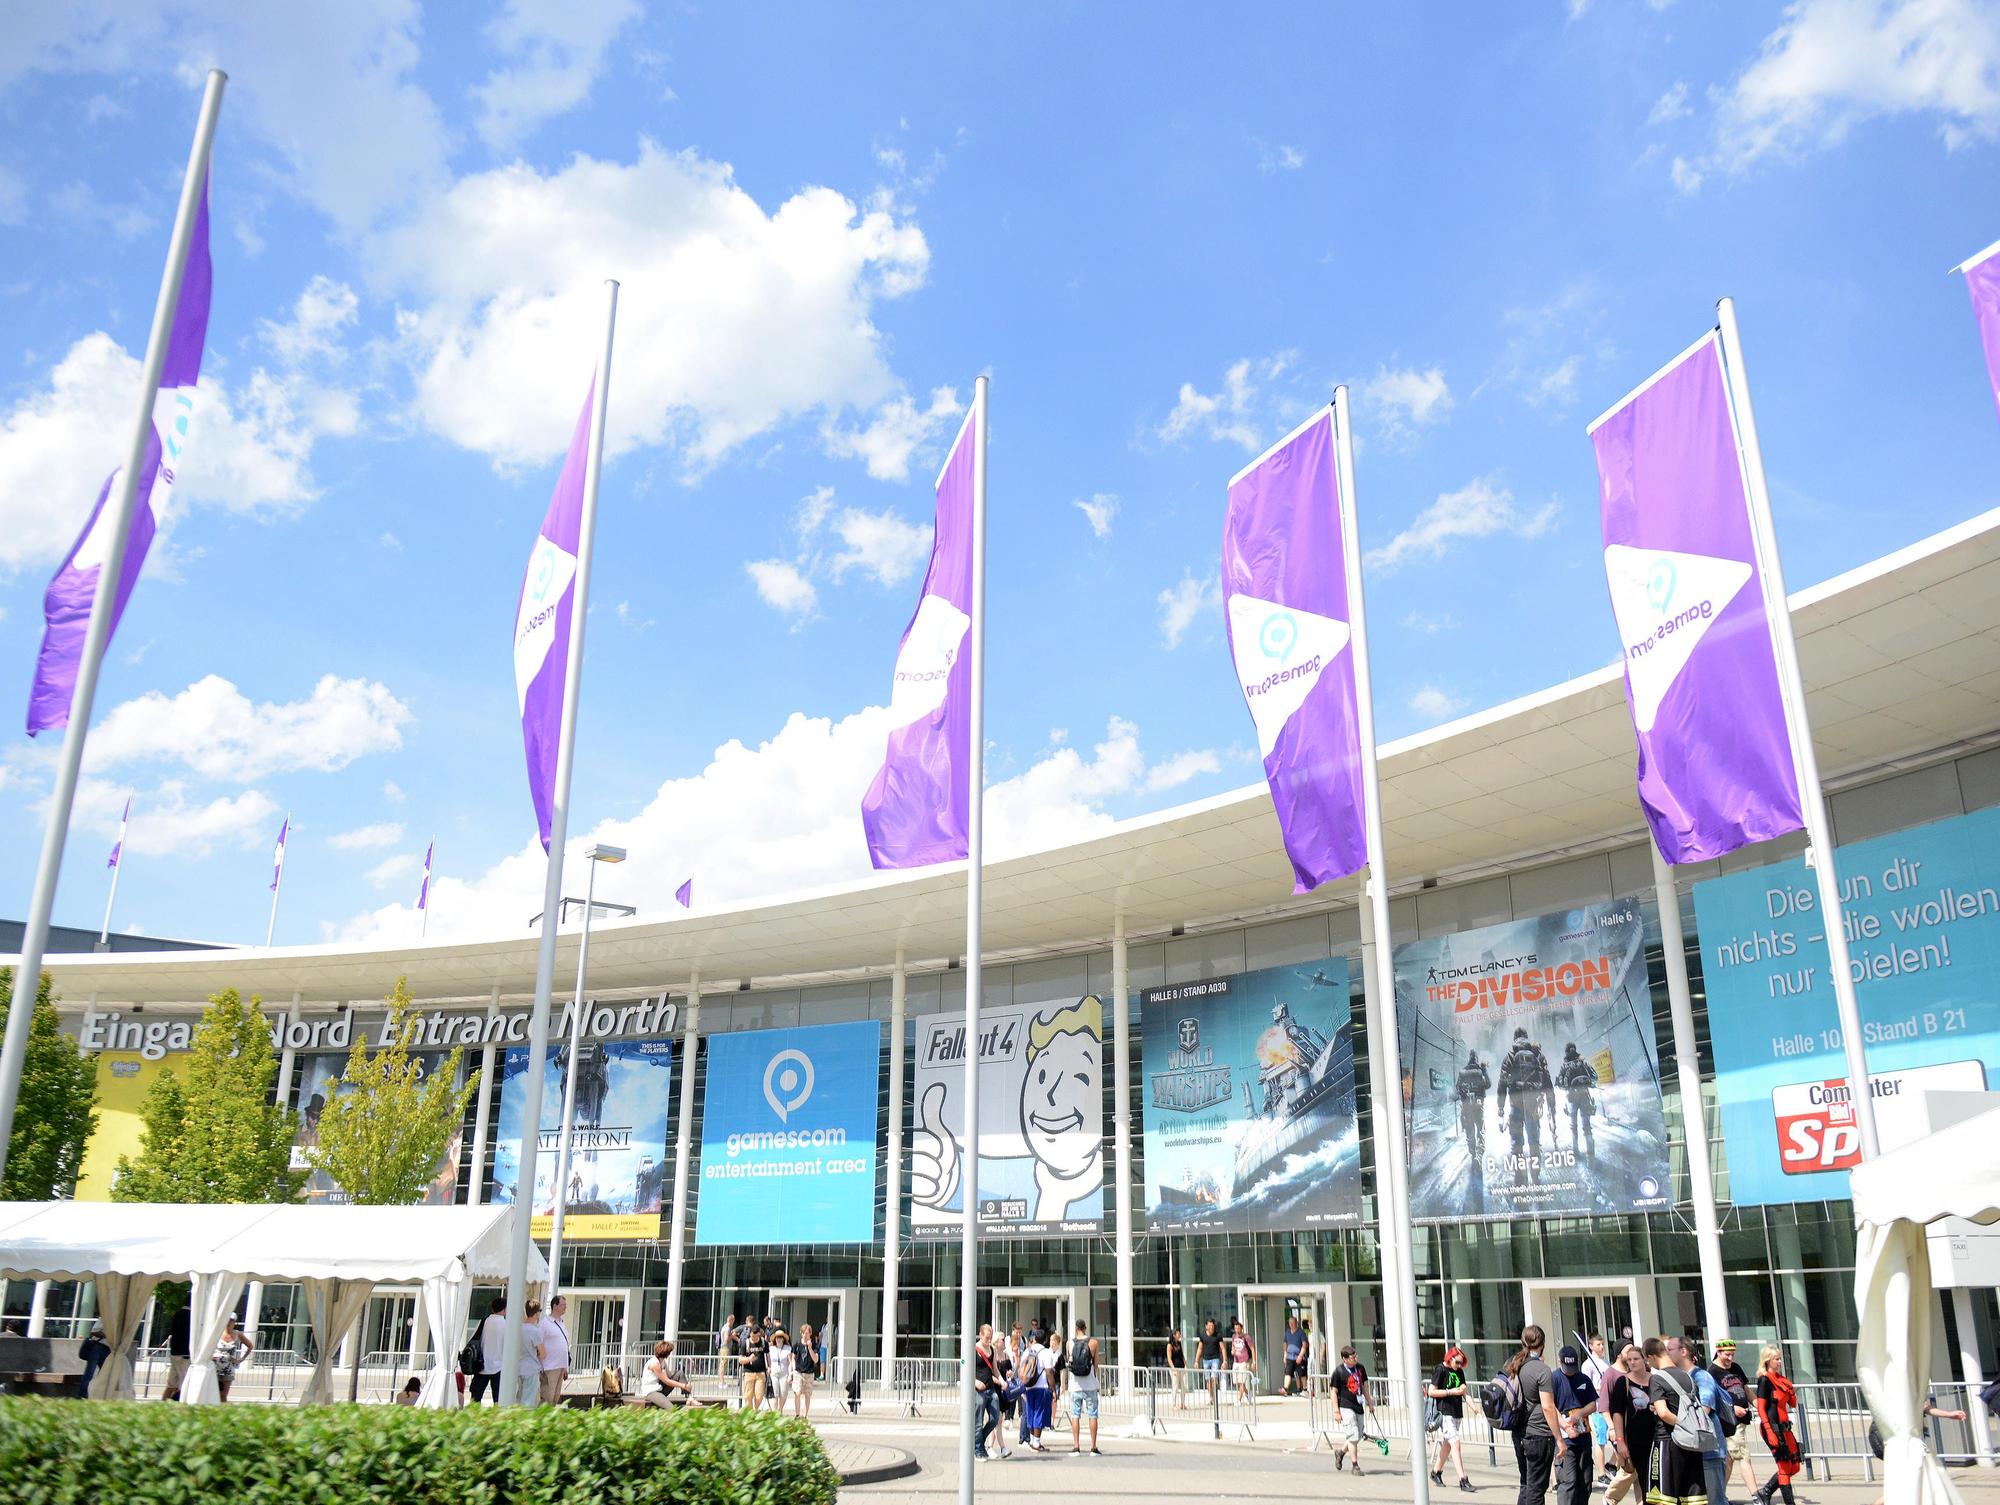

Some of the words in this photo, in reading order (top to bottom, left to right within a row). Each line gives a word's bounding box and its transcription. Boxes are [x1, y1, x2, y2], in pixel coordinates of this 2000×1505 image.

[1766, 885, 1814, 919] Die
[1837, 874, 1873, 904] un
[1882, 857, 1921, 892] dir
[1600, 913, 1624, 927] Halle
[1625, 910, 1633, 922] 6
[1717, 930, 1797, 968] nichts
[1891, 887, 2000, 932] wollen
[1558, 929, 1595, 943] gamescom
[1439, 965, 1468, 980] TOM
[1469, 954, 1538, 975] CLANCY'S
[1150, 990, 1171, 1002] HALLE
[1172, 989, 1178, 999] 8
[1183, 985, 1207, 998] STAND
[1208, 981, 1227, 993] A030
[1426, 983, 1457, 1002] THE
[1455, 956, 1611, 1013] DIVISION
[1768, 967, 1816, 998] nur
[556, 992, 678, 1039] North
[928, 1024, 999, 1061] Fallut
[999, 1021, 1016, 1054] 4
[1772, 1035, 1815, 1057] Halle
[1864, 1016, 1918, 1044] Stand
[1923, 1012, 1938, 1034] B
[1943, 1007, 1967, 1031] 21
[1168, 1047, 1214, 1070] WORLD
[1152, 1070, 1232, 1107] WARSHIPS
[1809, 1078, 1903, 1105] Comter
[1158, 1118, 1187, 1135] ACTION
[1189, 1113, 1228, 1133] STATIONS
[726, 1127, 846, 1157] gamescom
[1164, 1136, 1222, 1148] worldofwarships.eu
[705, 1158, 822, 1179] entertainment
[826, 1158, 867, 1174] area
[1487, 1159, 1500, 1172] 8.
[1503, 1154, 1540, 1171] März
[1544, 1150, 1576, 1168] 2016
[1490, 1182, 1577, 1195] www.thedivisiongame.com
[1633, 1198, 1668, 1206] UBISOFT
